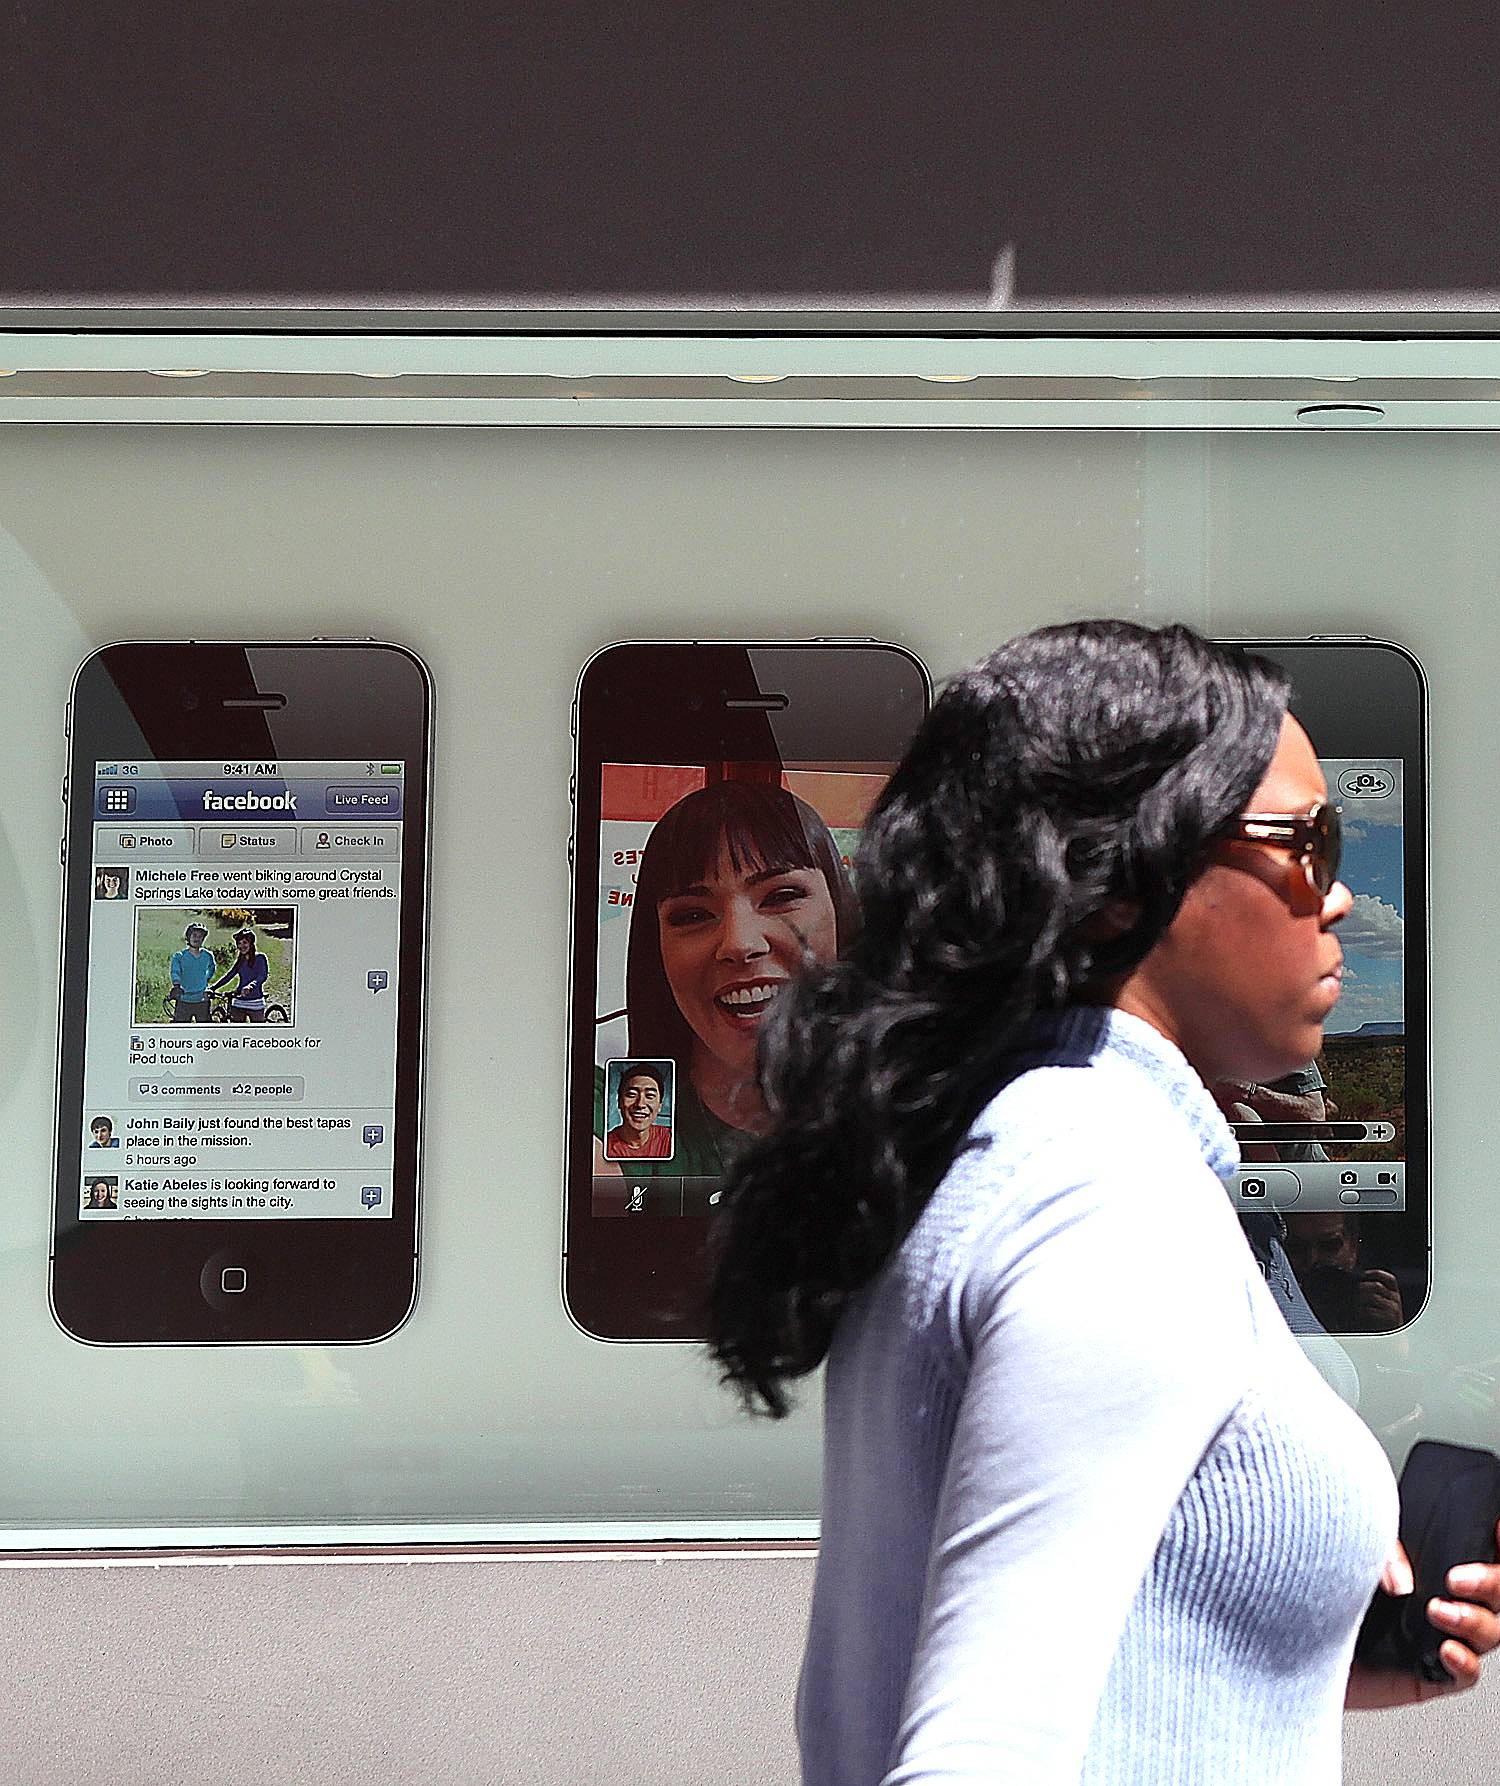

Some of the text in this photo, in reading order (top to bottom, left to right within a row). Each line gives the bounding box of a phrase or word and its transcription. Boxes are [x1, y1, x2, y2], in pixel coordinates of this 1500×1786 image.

[122, 765, 138, 775] 3G
[223, 764, 277, 775] 9:41 AM
[202, 790, 297, 811] facebook
[335, 794, 388, 805] Live Feed
[140, 836, 173, 846] Photo
[239, 836, 276, 846] Status
[335, 836, 384, 846] Check In
[135, 870, 382, 885] Michele Free went biking around Crystal
[135, 887, 397, 901] Springs Lake today with some great friends.
[148, 1037, 321, 1051] 3 hours ago via Facebook for
[129, 1053, 193, 1064] iPod touch
[151, 1085, 221, 1095] 3 comments
[244, 1085, 292, 1097] 2 people
[126, 1118, 351, 1132] John Baily just found the best tapas
[126, 1135, 252, 1149] place in the mission.
[126, 1154, 197, 1167] 5 hours ago
[125, 1178, 336, 1193] Katie Abeles is looking forward to
[124, 1196, 294, 1210] seeing the sights in the city.
